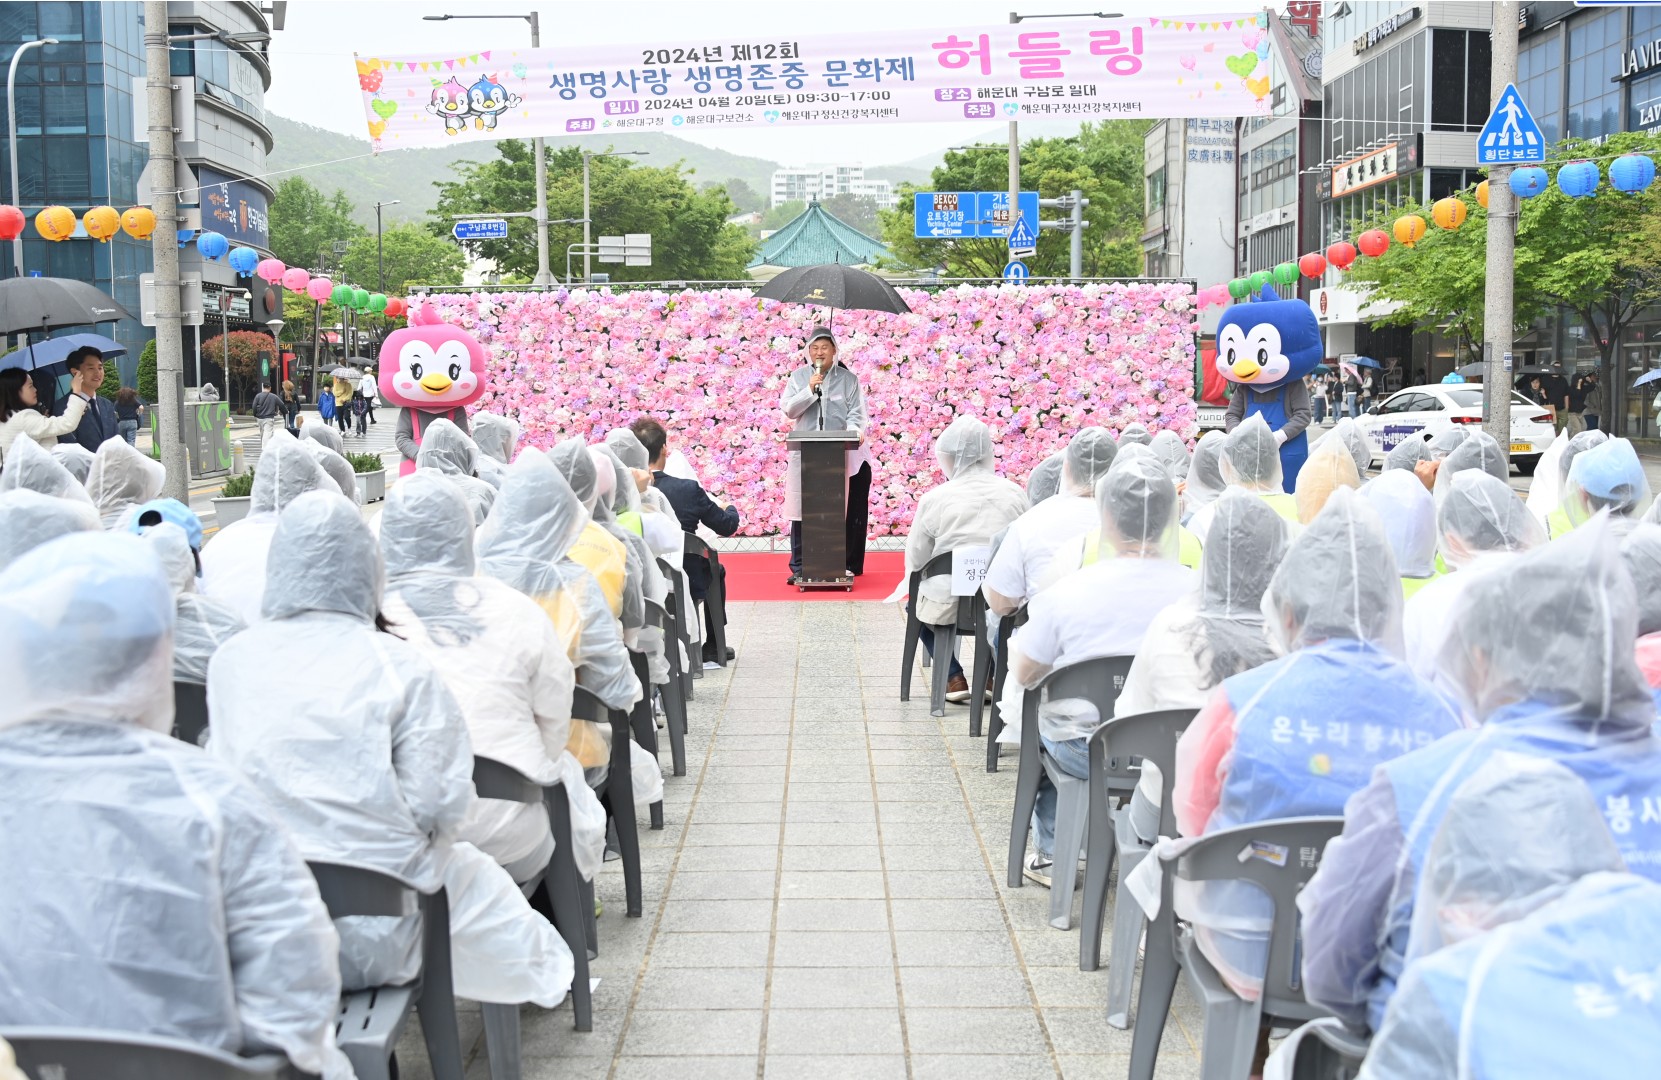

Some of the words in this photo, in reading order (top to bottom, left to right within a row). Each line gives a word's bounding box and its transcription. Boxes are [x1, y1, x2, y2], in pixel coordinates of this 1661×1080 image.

[642, 45, 723, 66] 2024년
[731, 41, 799, 61] 제12회
[931, 26, 1144, 79] 허들링
[1621, 48, 1640, 77] LA
[549, 68, 672, 100] 생명사랑
[684, 61, 809, 93] 생명존중
[821, 56, 915, 87] 문화제
[608, 102, 636, 114] 일시
[644, 97, 693, 110] 2024년
[698, 95, 730, 108] 04월
[735, 93, 792, 106] 20일(토)
[796, 90, 891, 103] 09:30~17:00
[940, 88, 970, 100] 장소
[977, 88, 1018, 99] 해운대
[1023, 86, 1065, 97] 구남로
[1069, 84, 1097, 96] 일대
[569, 120, 592, 131] 주최
[616, 117, 664, 128] 해운대구청
[686, 112, 754, 125] 해운대구보건소
[782, 108, 899, 121] 해운대구정신건강복지센터
[967, 105, 992, 116] 주관
[1021, 102, 1142, 114] 해운대구정신건강복지센터
[1484, 149, 1539, 160] 횡단보도
[933, 194, 958, 204] BEXCO
[927, 211, 964, 221] 요트경기장
[1270, 715, 1348, 747] 온누리
